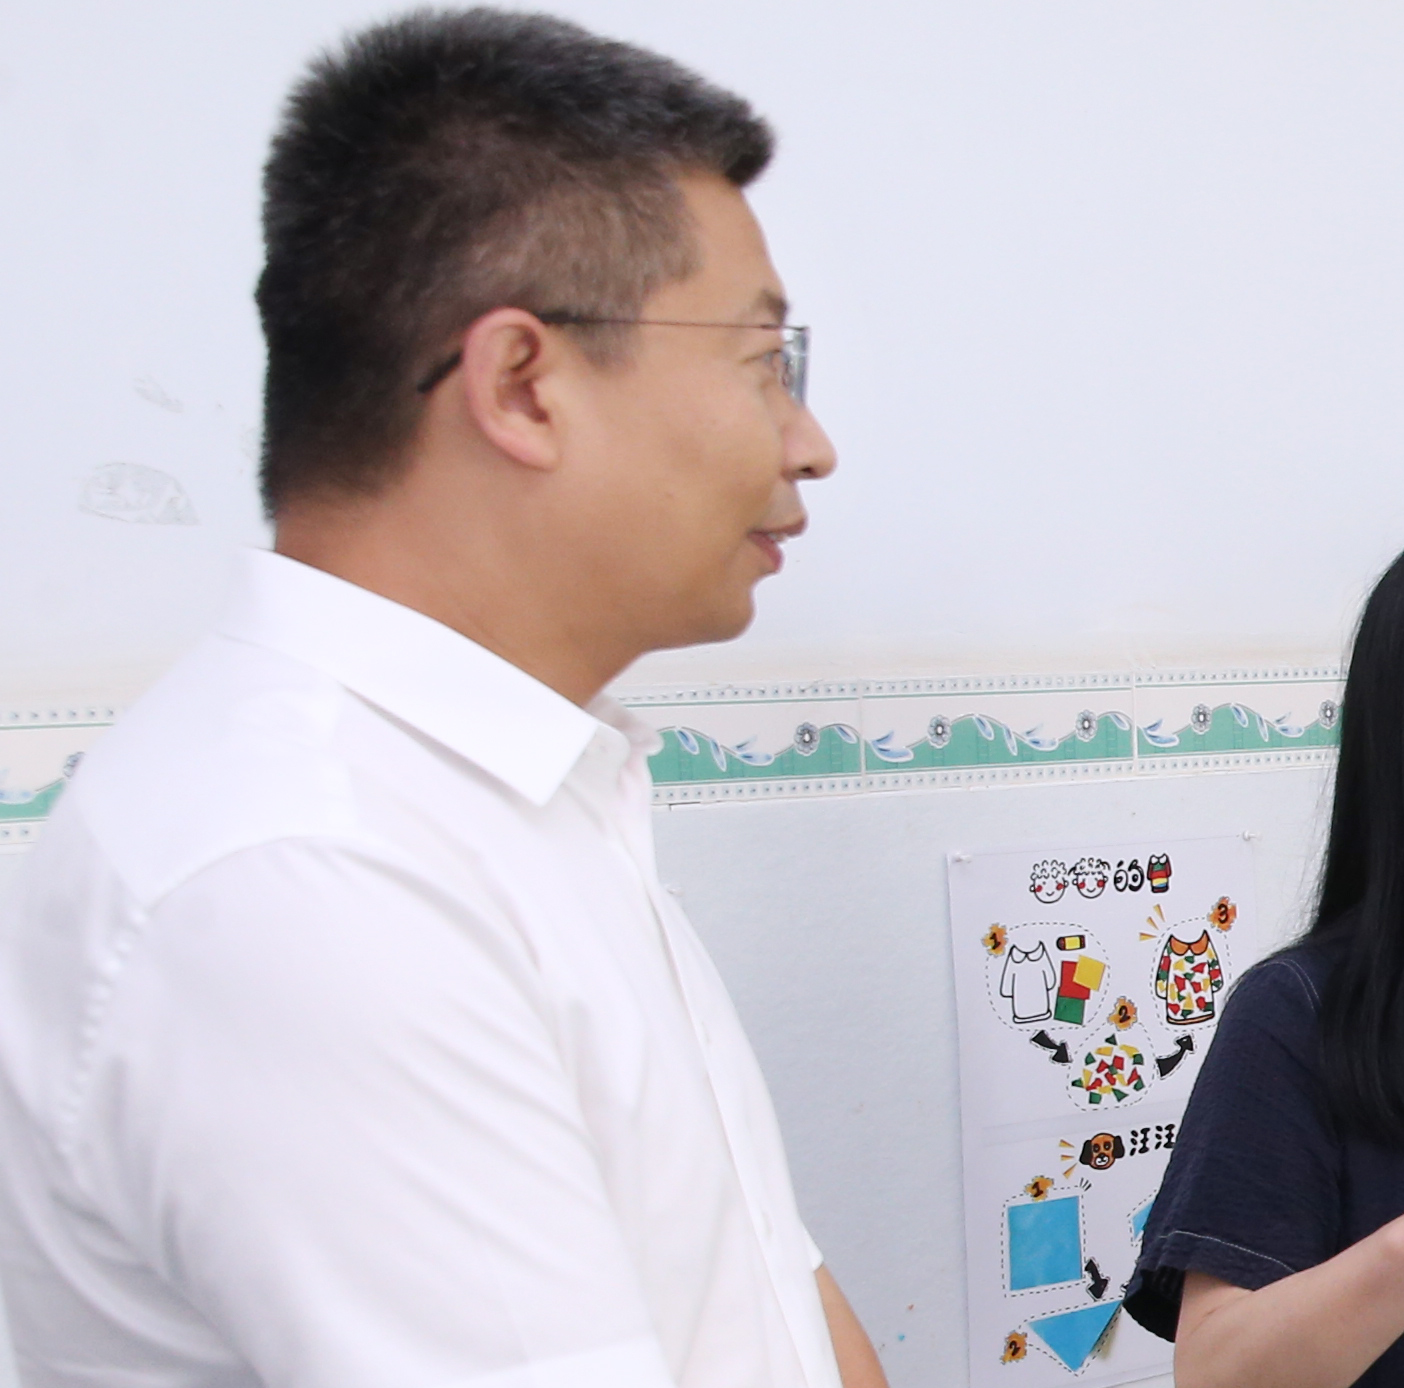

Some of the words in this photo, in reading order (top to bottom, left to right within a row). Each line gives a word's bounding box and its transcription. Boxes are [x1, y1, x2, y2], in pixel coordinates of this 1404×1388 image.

[1114, 859, 1145, 892] 的
[1218, 903, 1229, 924] 3
[989, 932, 1001, 950] 1
[1118, 1005, 1131, 1023] 2
[1032, 1181, 1044, 1198] 1
[1009, 1340, 1021, 1357] 2
